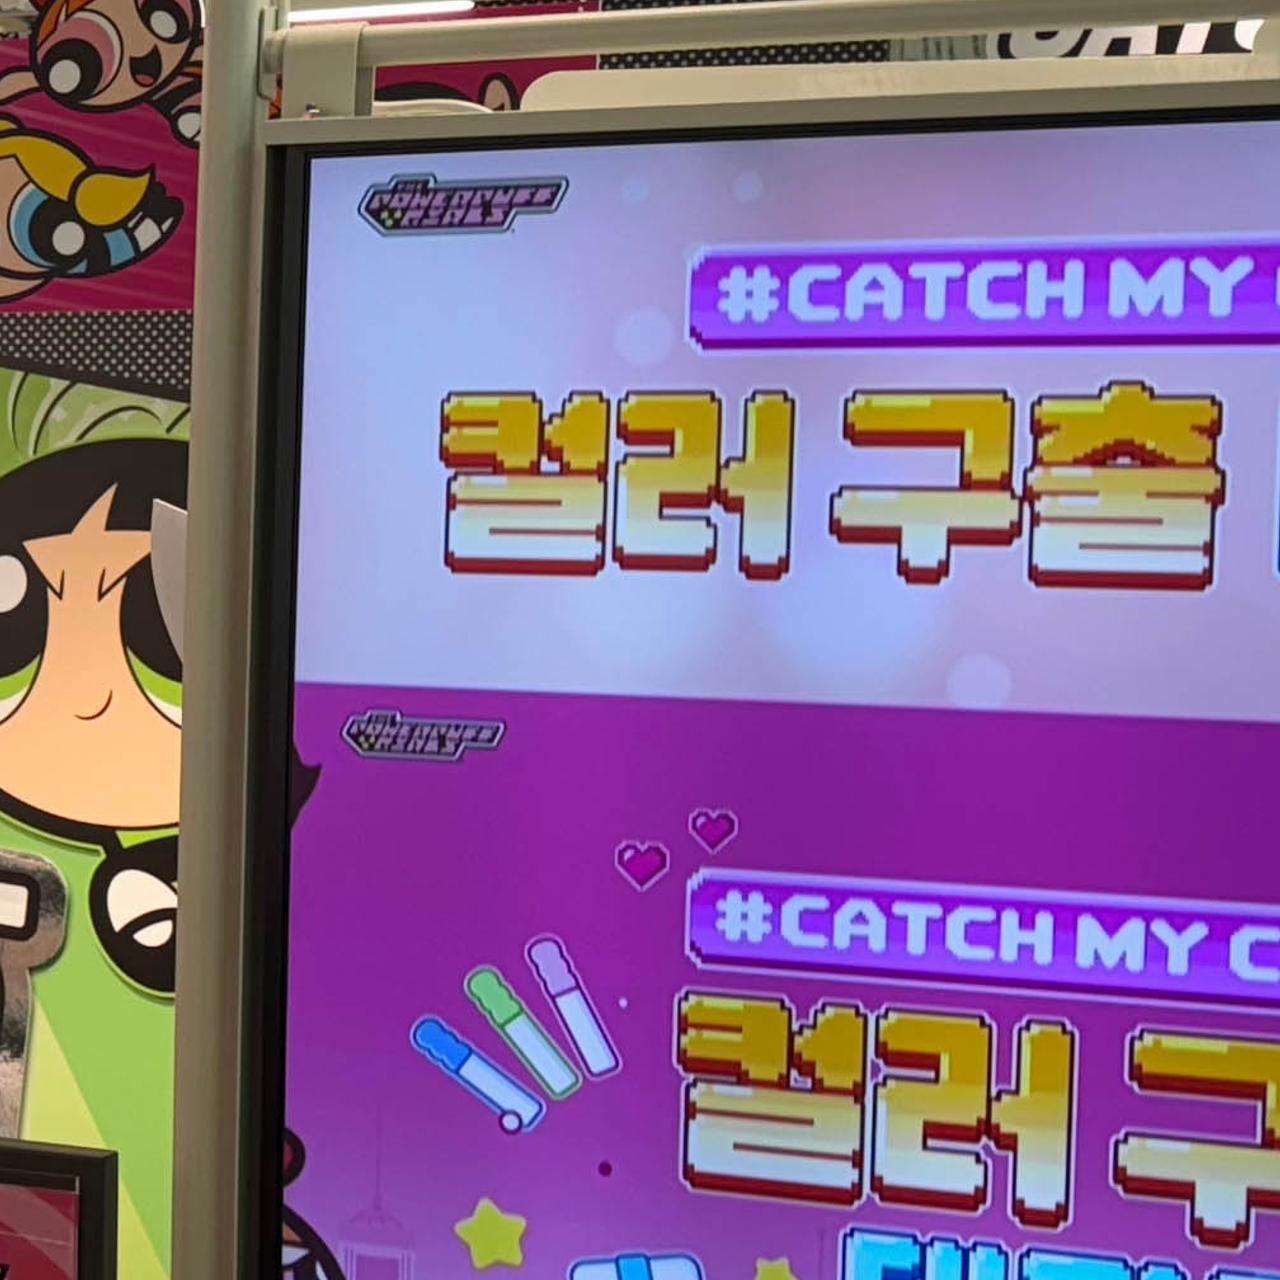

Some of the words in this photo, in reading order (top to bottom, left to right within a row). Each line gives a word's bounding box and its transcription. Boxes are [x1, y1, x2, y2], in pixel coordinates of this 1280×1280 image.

[716, 261, 1083, 322] #CATCH
[1108, 256, 1254, 318] MY
[439, 391, 794, 580] 컬러
[830, 380, 1226, 592] 구출
[715, 889, 1053, 968] #CATCH
[1076, 918, 1208, 976] MY
[677, 991, 1075, 1228] 컬러
